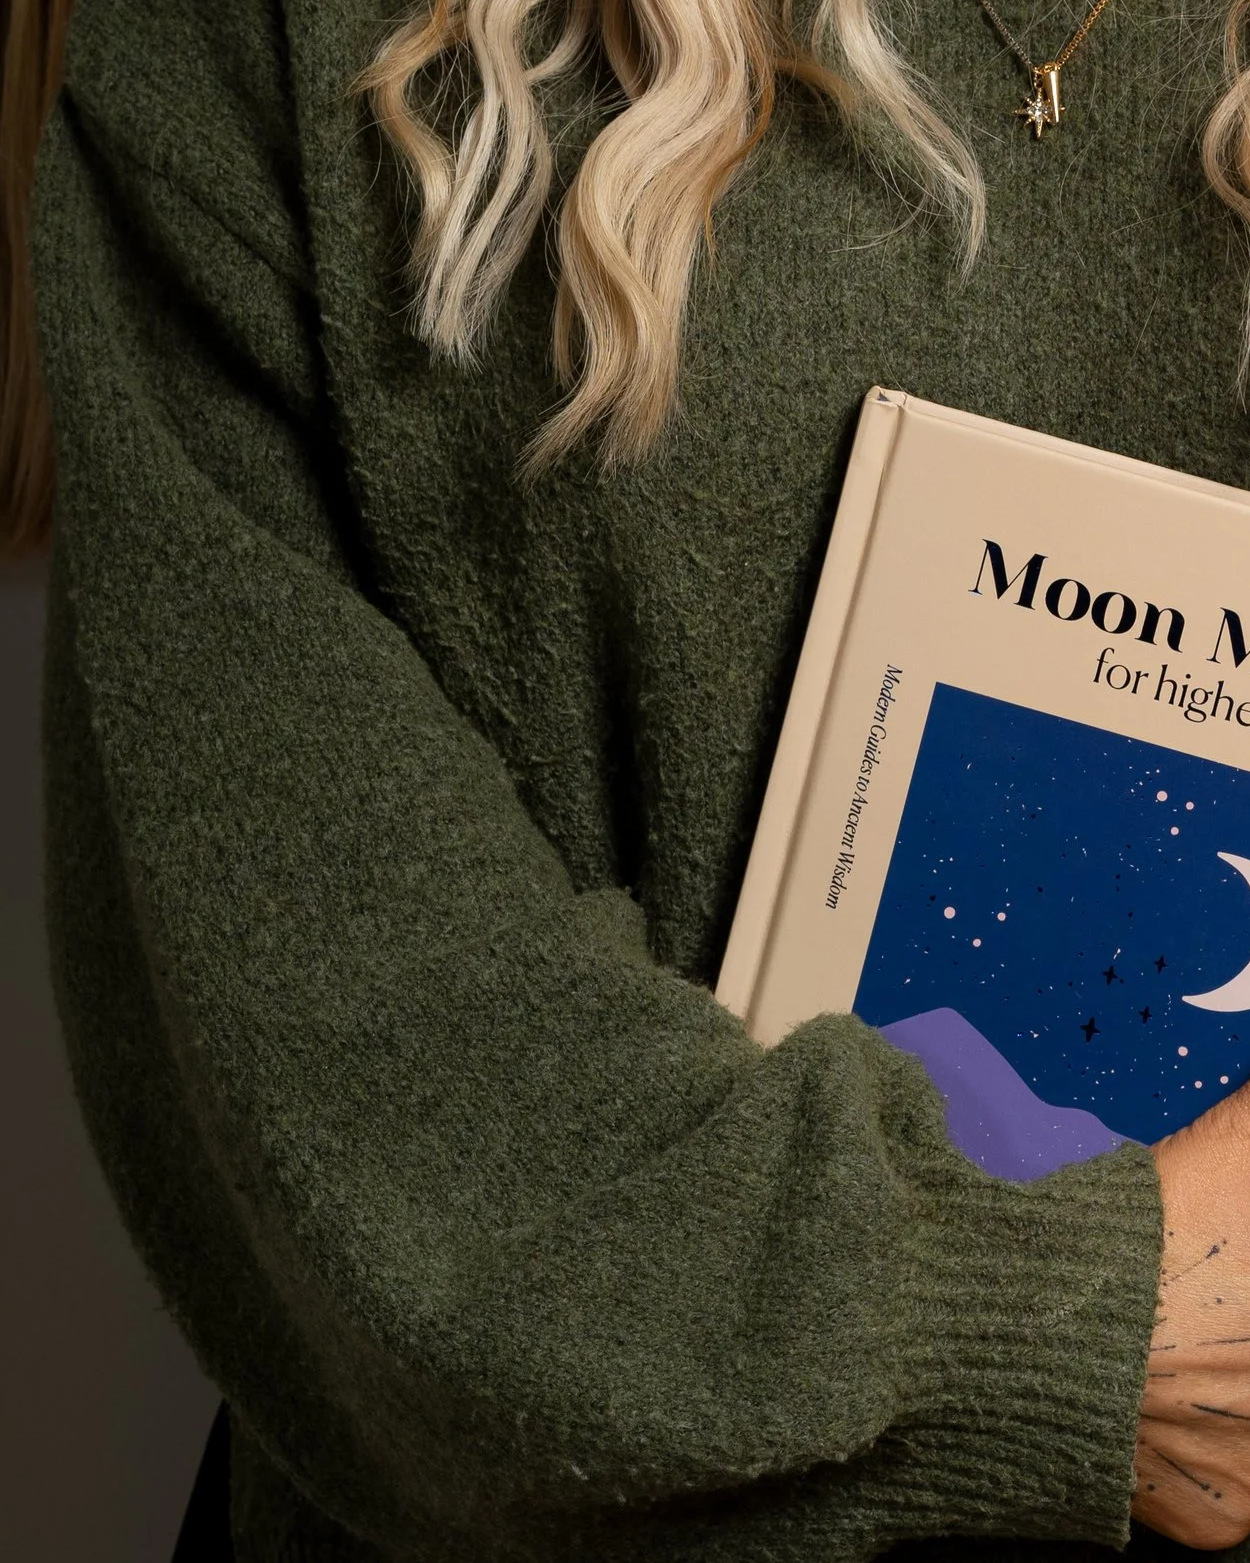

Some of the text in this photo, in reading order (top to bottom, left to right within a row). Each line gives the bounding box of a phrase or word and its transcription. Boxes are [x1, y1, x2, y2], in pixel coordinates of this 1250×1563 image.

[968, 538, 1186, 653] Moon
[1093, 647, 1149, 695] for
[825, 663, 903, 910] Modern Guides to Ancient Wisdom
